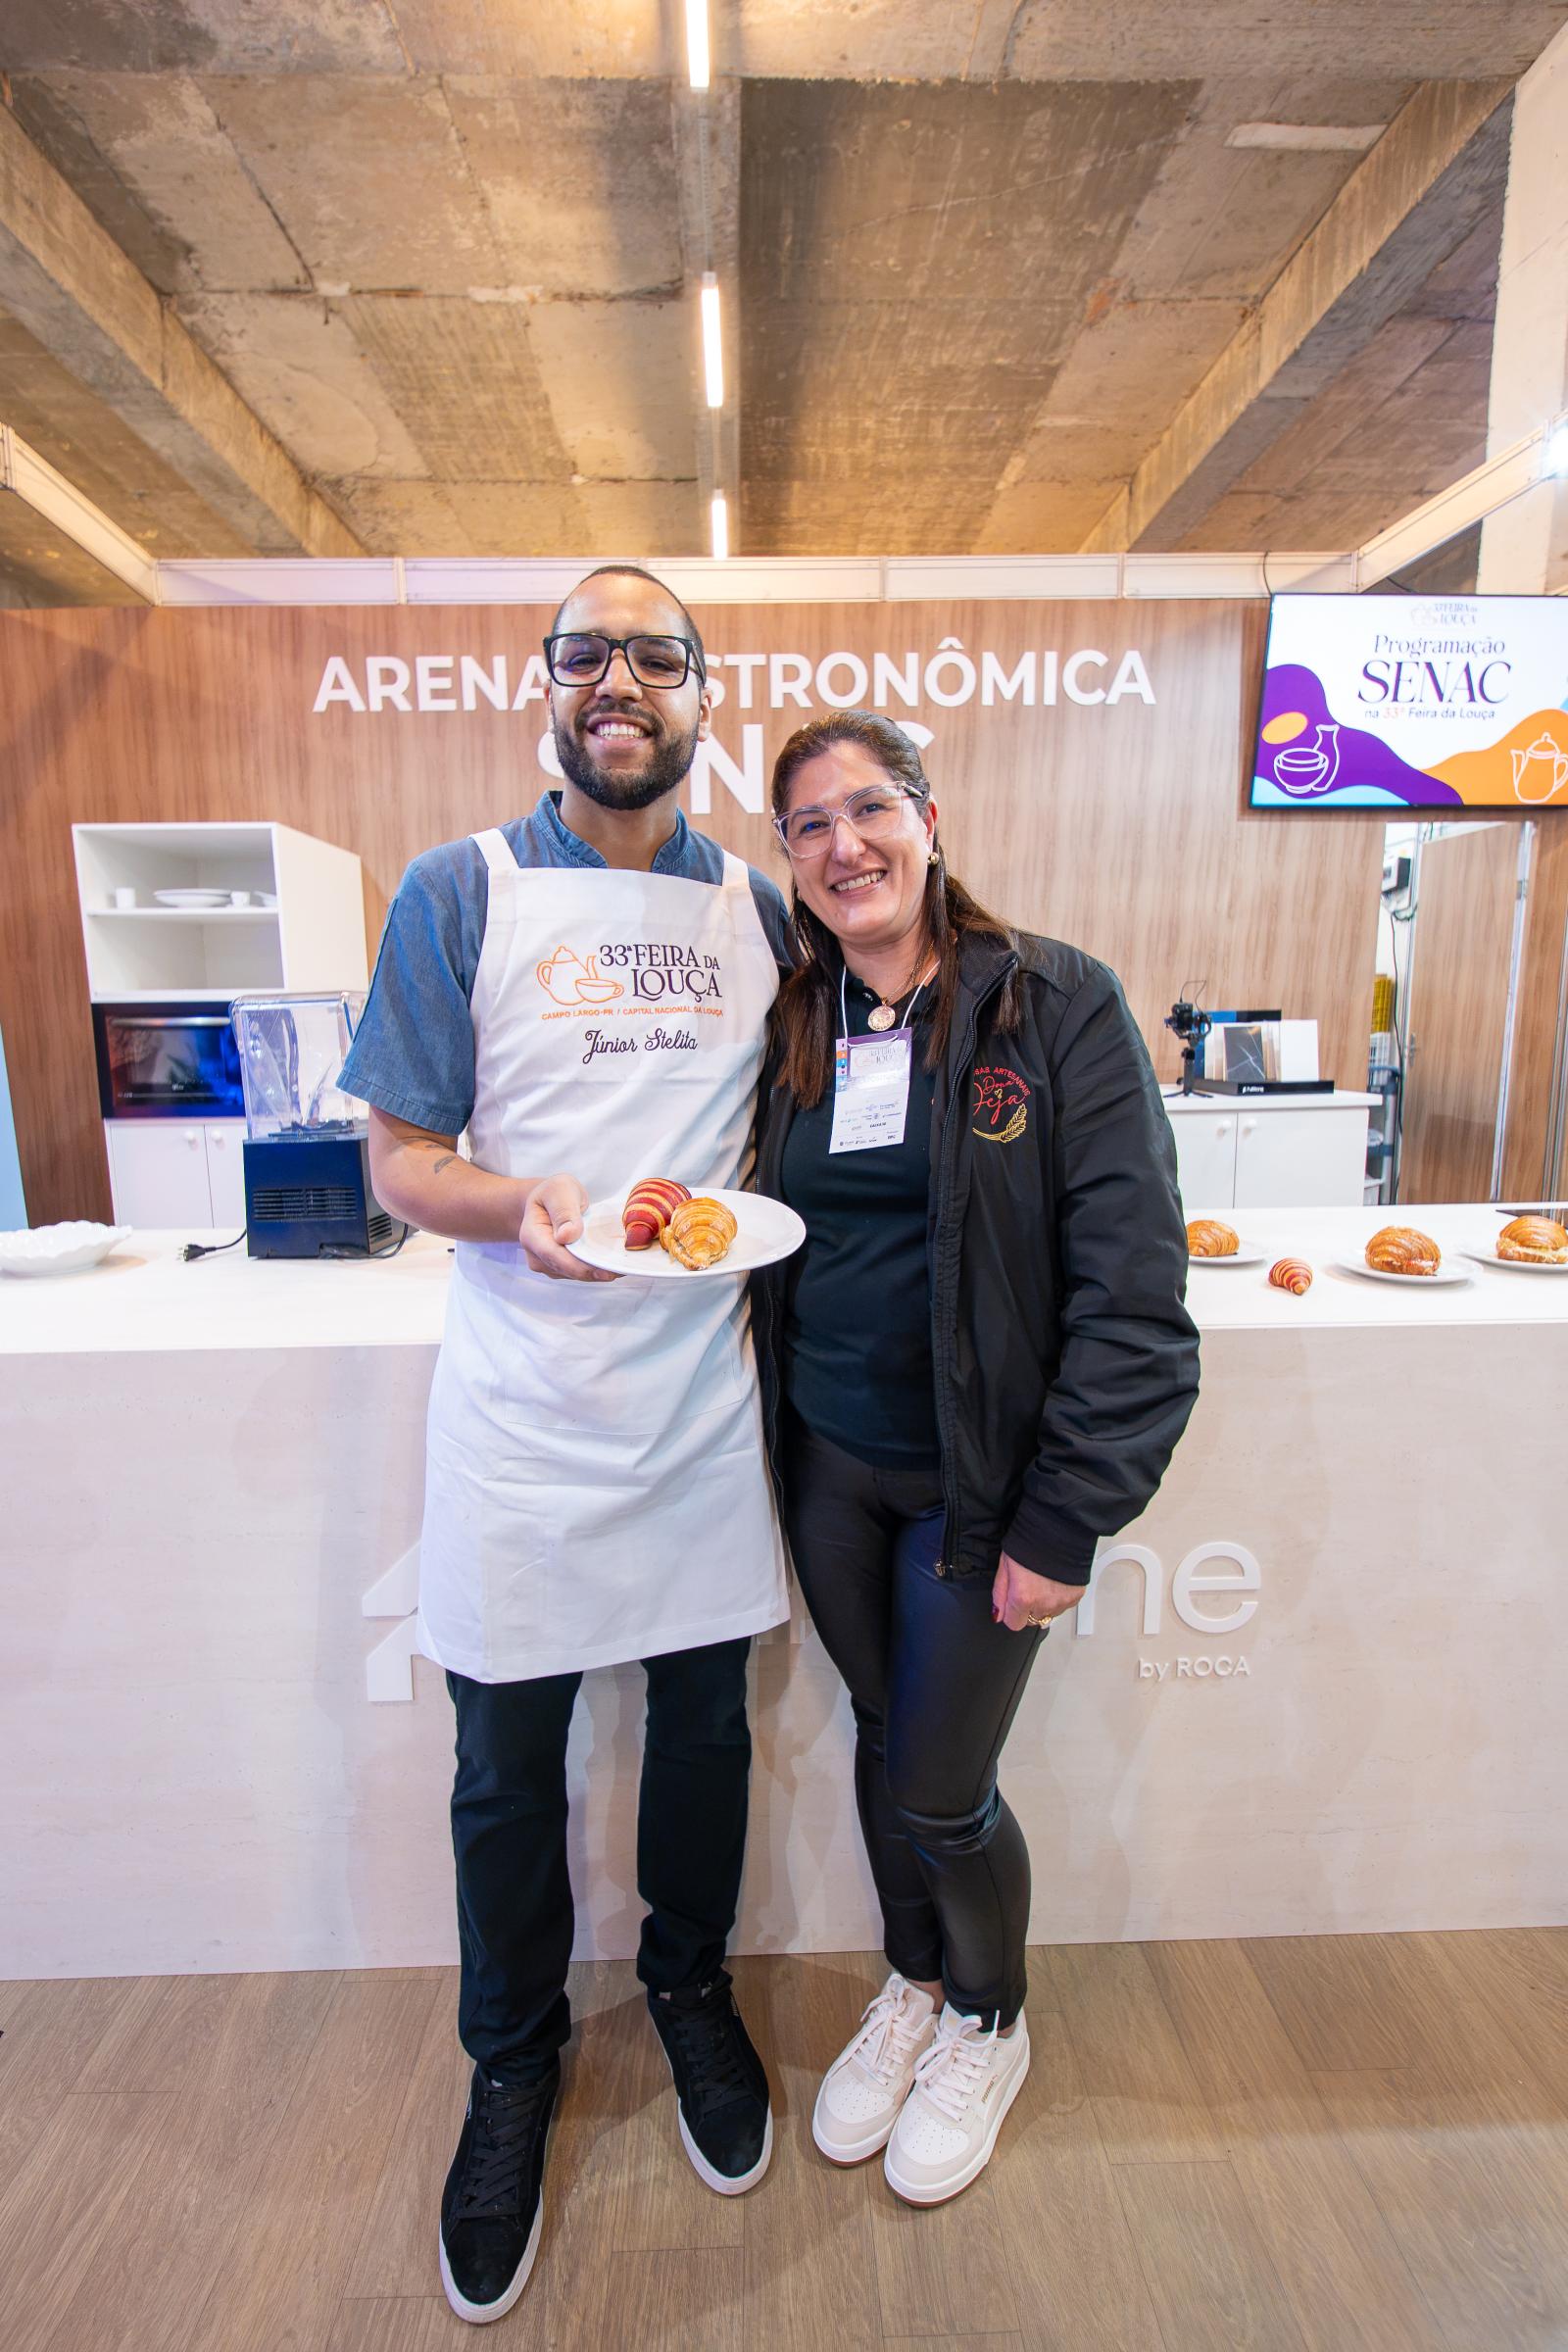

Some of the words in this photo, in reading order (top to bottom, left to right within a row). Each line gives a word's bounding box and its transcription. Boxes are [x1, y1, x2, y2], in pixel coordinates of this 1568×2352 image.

[1374, 634, 1505, 658] Programação
[312, 655, 551, 713] ARENA
[704, 637, 1157, 710] STRONÔMICA
[1357, 660, 1512, 705] SENAC
[1364, 710, 1380, 719] na
[1408, 707, 1438, 719] Feira
[1441, 707, 1456, 719] da
[1459, 707, 1495, 721] Louça
[633, 944, 701, 968] FEIRA
[704, 955, 721, 970] DA
[630, 968, 723, 1004] LOUÇA
[541, 1010, 571, 1021] CAMPO
[572, 1007, 613, 1017] LARGO-PR
[622, 1005, 655, 1016] CAPITAL
[655, 1004, 692, 1015] NACIONAL
[582, 1029, 638, 1065] Júnior
[644, 1027, 699, 1052] Stelita
[1139, 1656, 1170, 1682] by
[1176, 1654, 1251, 1679] ROCA
